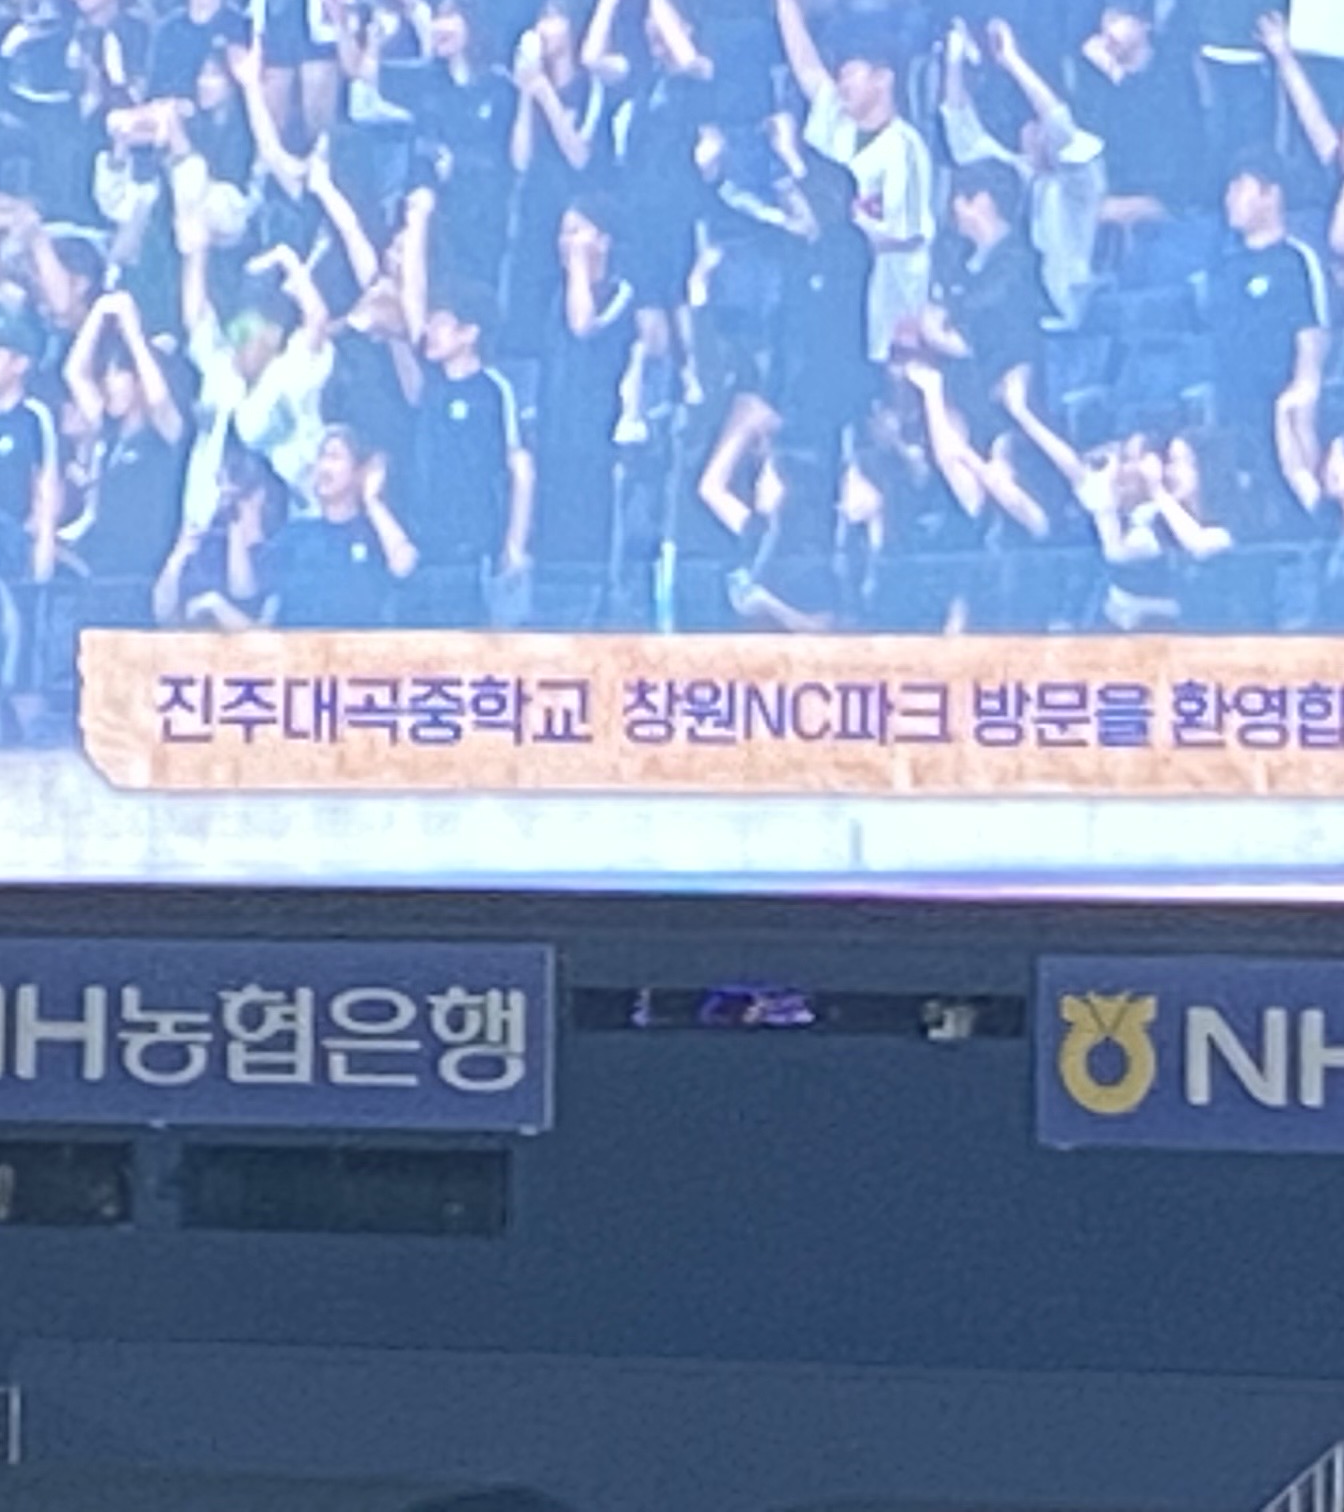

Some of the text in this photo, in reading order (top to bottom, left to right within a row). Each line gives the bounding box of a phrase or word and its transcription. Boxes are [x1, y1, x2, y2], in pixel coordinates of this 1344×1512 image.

[156, 674, 594, 747] 진주대곡중학교
[622, 676, 953, 748] 창원NC파크
[971, 680, 1155, 749] 방문을
